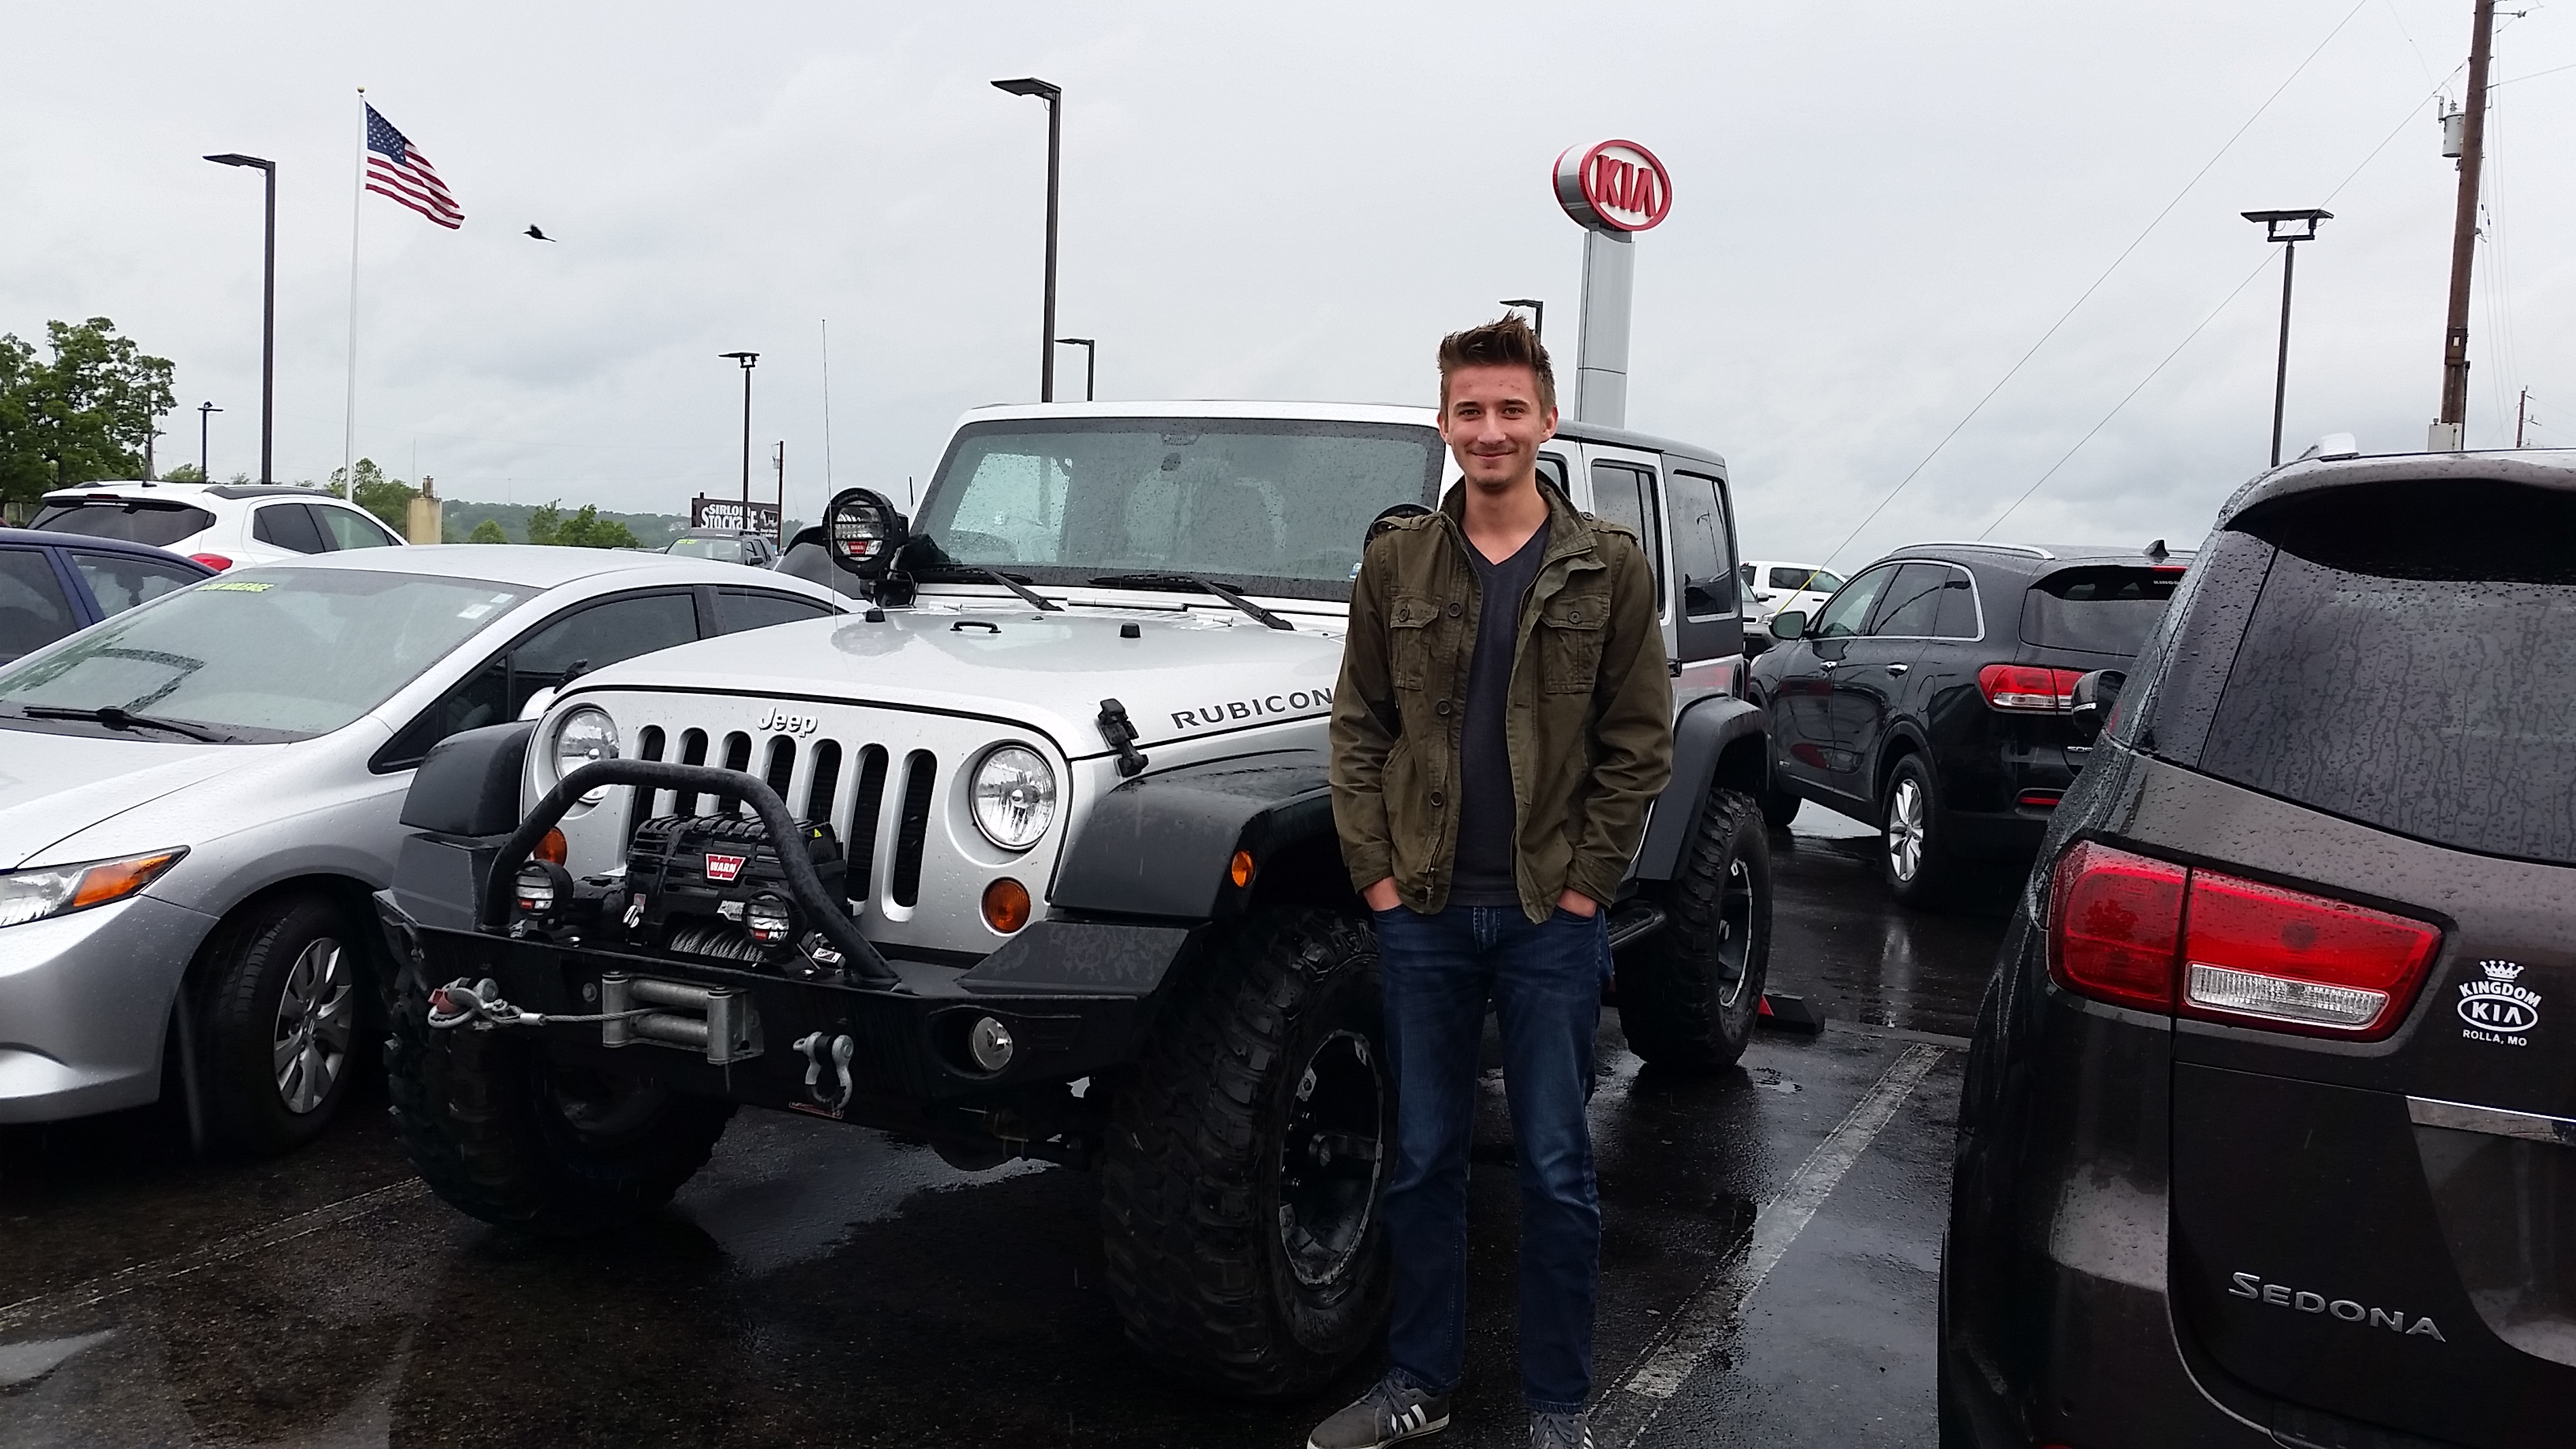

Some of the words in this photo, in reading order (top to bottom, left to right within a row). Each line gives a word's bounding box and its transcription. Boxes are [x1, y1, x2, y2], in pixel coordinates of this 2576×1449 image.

[1595, 155, 1657, 217] KIA
[758, 707, 818, 738] Jeep
[1171, 688, 1333, 729] RUBICON
[710, 861, 737, 873] WARN
[2458, 981, 2542, 1008] KINGDOM
[2472, 1002, 2522, 1024] KIA
[2462, 1029, 2504, 1044] ROLLA,
[2507, 1035, 2528, 1046] MO
[2229, 1271, 2446, 1342] SEDONA
